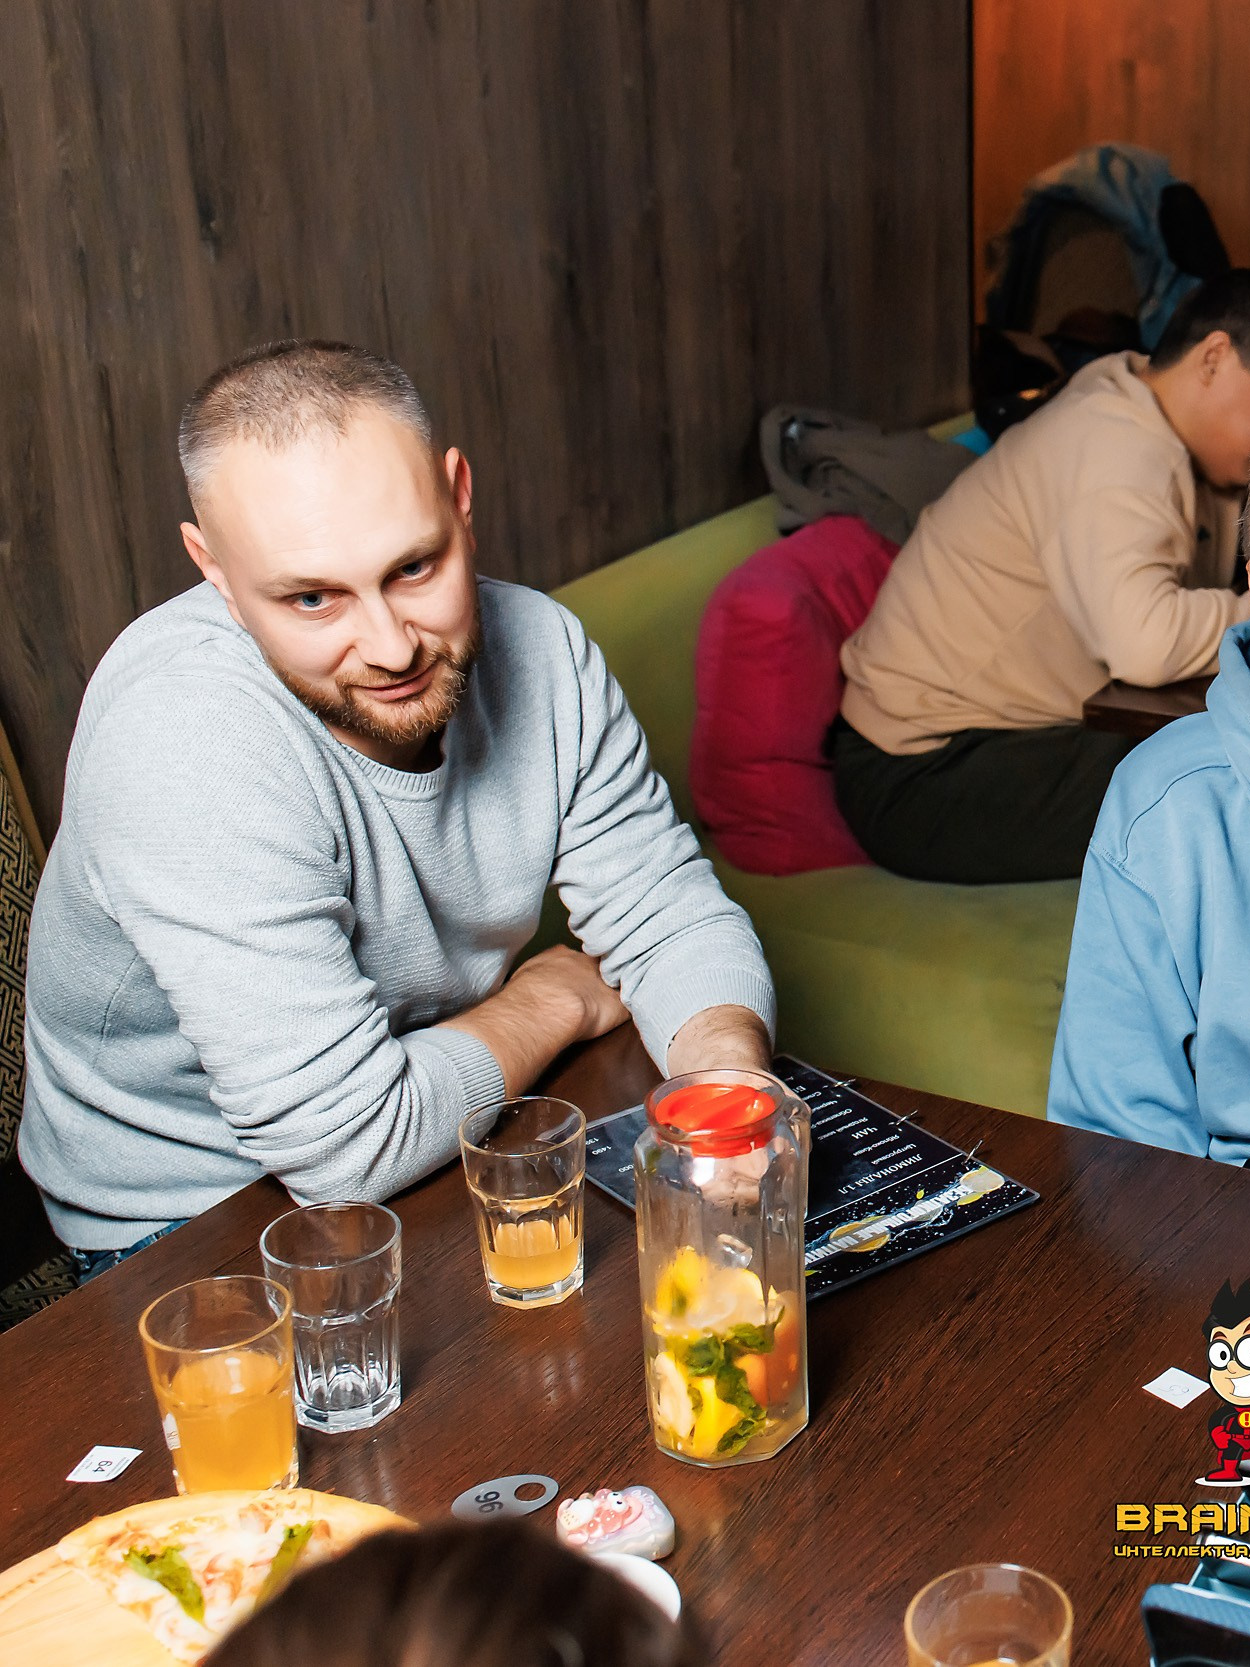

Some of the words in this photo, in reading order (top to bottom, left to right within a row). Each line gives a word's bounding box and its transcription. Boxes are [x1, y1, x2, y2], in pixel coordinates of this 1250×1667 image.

[855, 1153, 923, 1187] ЛИМОНАДЫ
[92, 1460, 113, 1473] 64
[474, 1491, 504, 1514] 96
